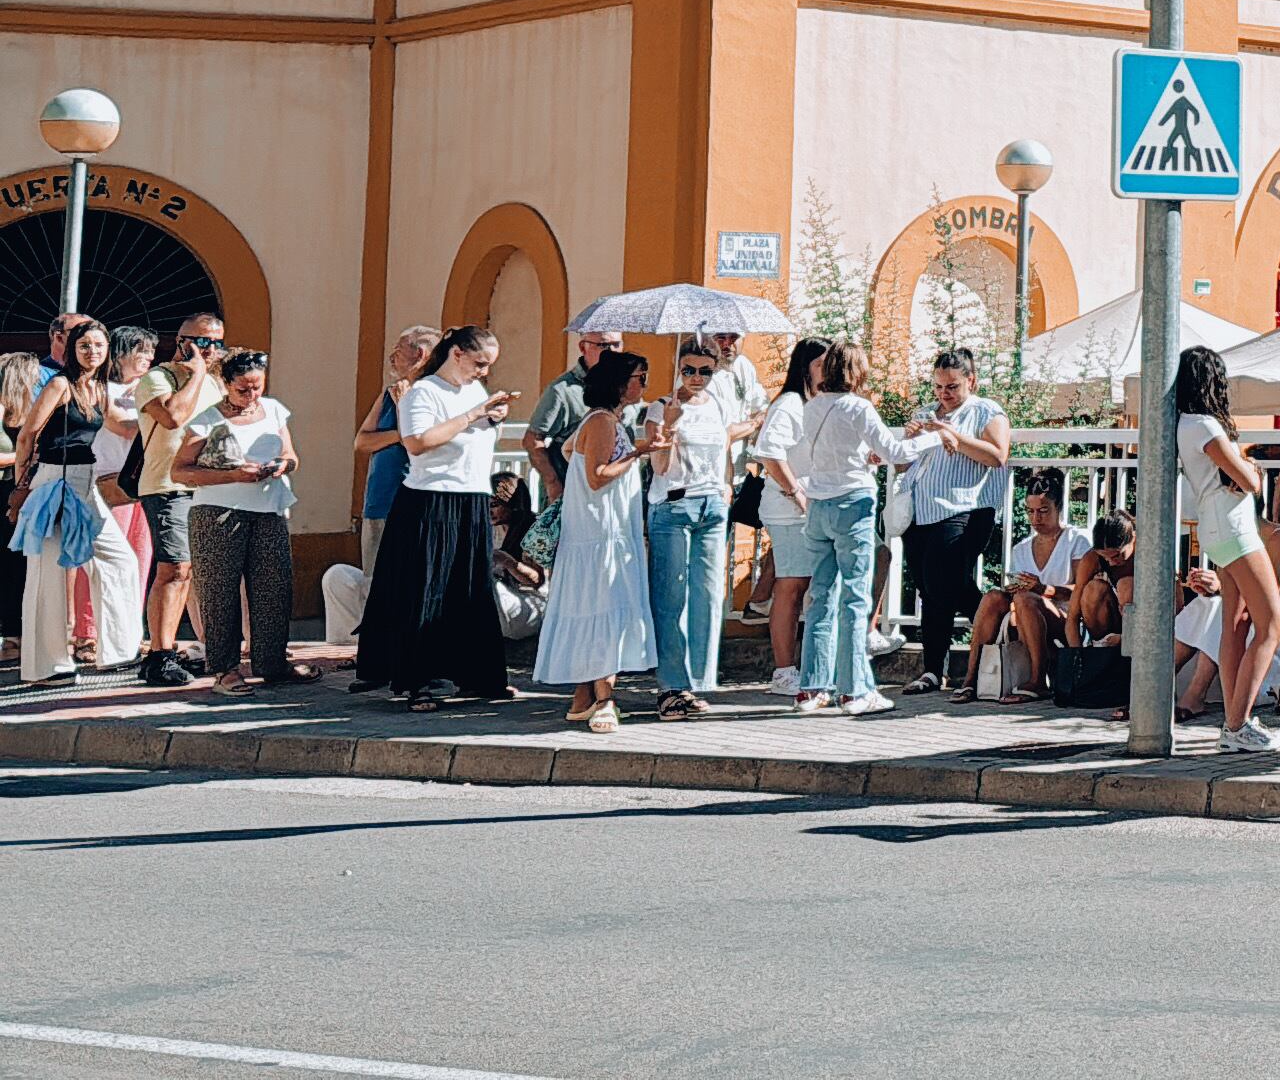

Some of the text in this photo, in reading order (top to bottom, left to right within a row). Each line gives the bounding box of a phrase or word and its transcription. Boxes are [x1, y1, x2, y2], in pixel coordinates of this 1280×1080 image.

[0, 175, 110, 208] UERA
[160, 196, 187, 220] 2
[933, 205, 1035, 247] SOMBR
[743, 238, 769, 248] PLAZA
[735, 250, 773, 260] UNIDAD
[719, 259, 777, 271] NACIONAL
